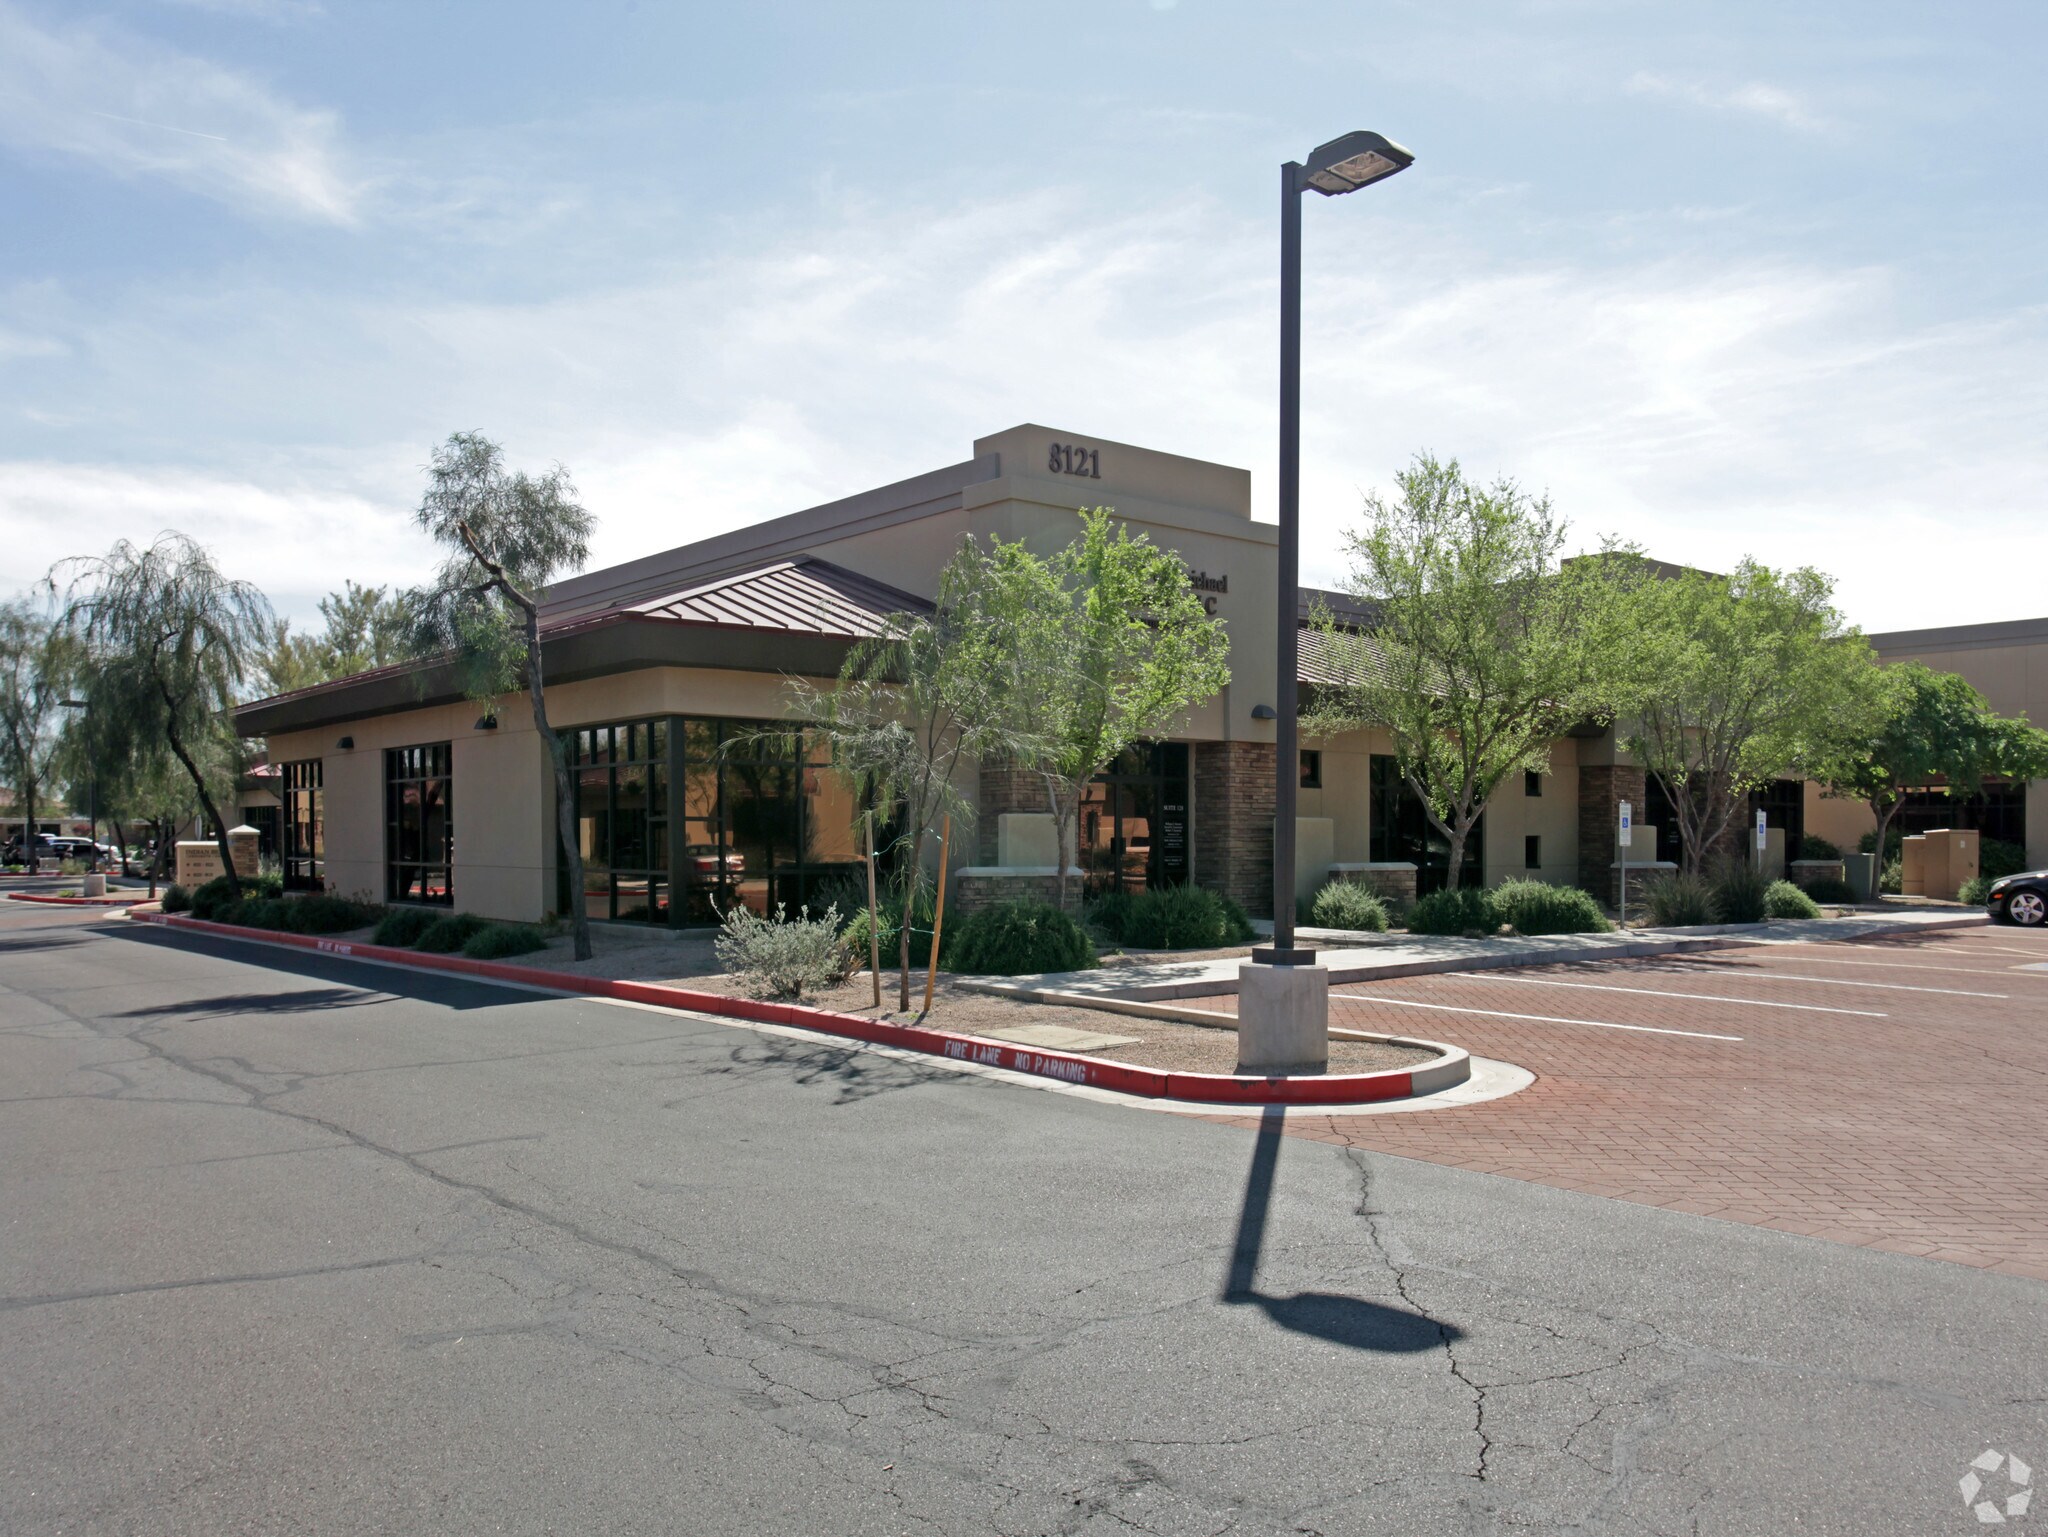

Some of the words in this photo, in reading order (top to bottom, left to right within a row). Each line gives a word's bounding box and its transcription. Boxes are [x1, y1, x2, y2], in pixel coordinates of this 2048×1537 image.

[1049, 442, 1101, 479] 8121
[944, 1040, 968, 1059] FIRE
[973, 1045, 1002, 1065] LANE
[1014, 1052, 1030, 1070] NO
[1034, 1056, 1086, 1082] PARKING
